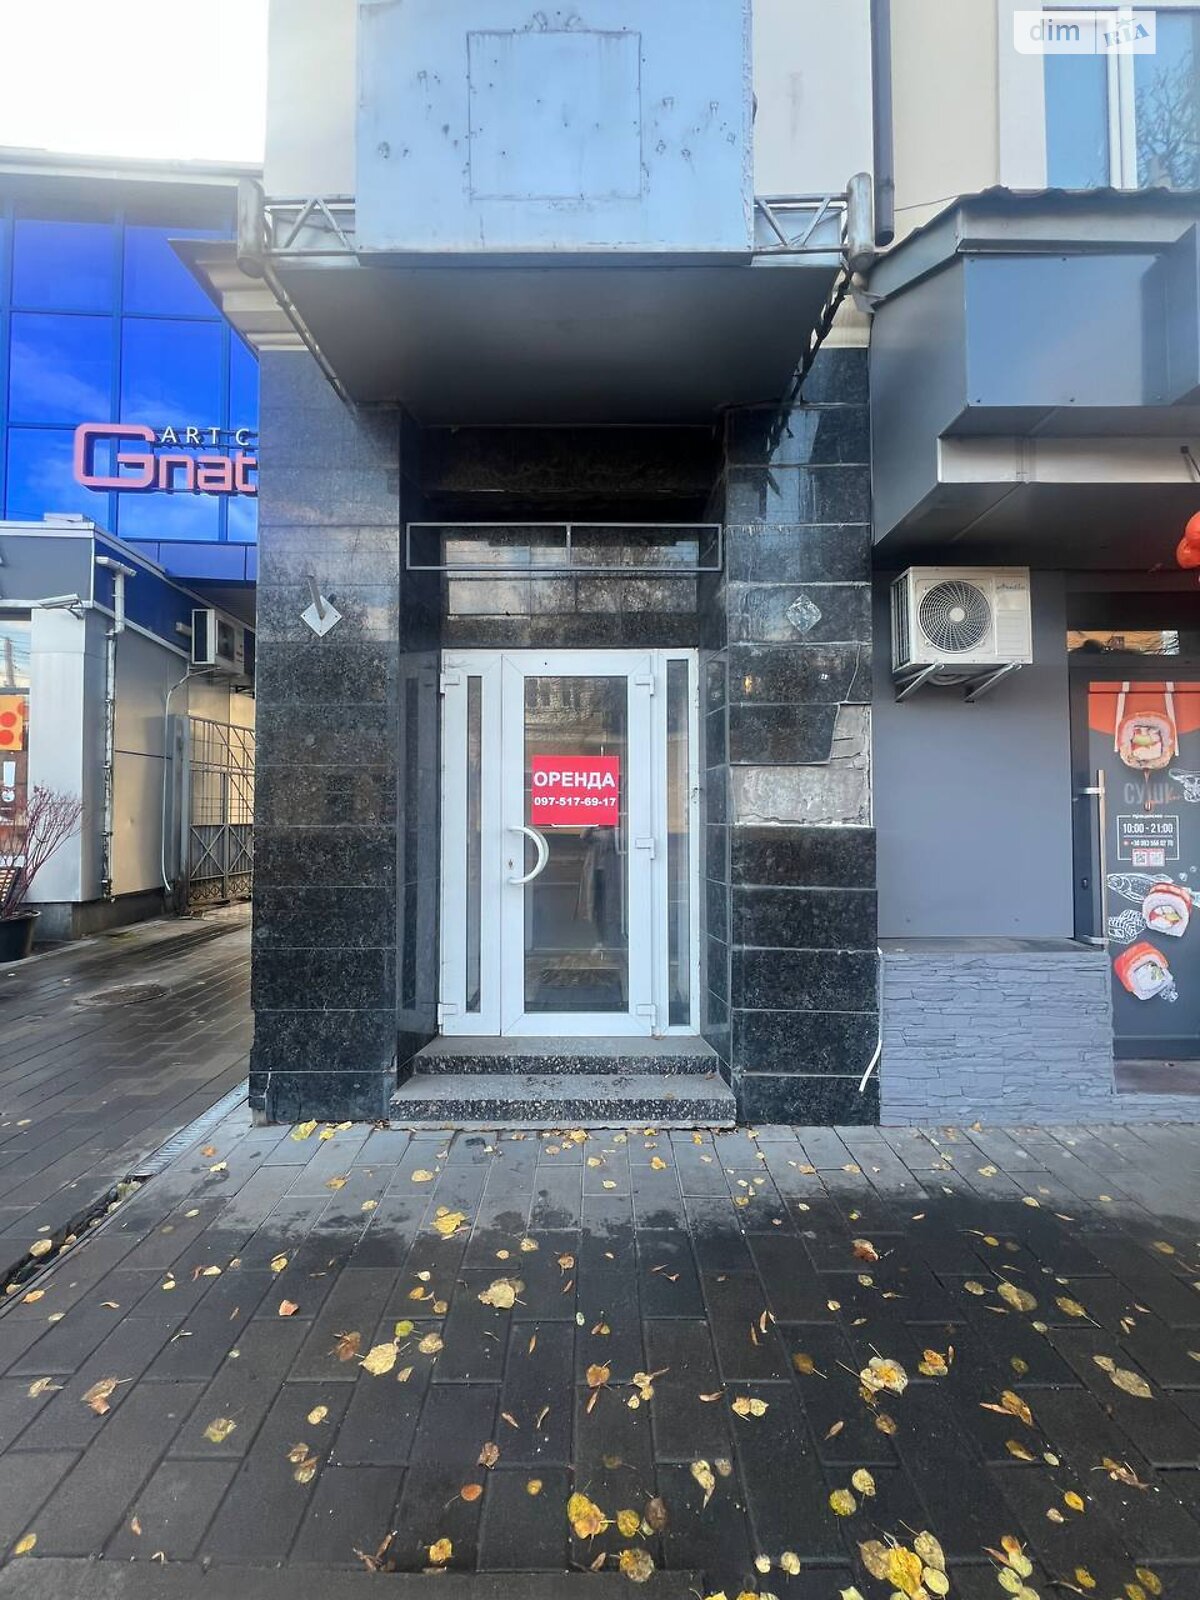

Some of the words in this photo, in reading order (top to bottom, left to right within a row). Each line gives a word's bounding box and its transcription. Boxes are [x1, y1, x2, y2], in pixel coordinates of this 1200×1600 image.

[161, 426, 221, 444] ART
[534, 771, 616, 790] ОРЕНДА
[534, 796, 616, 807] 097-517-69-17
[1123, 823, 1145, 834] 10:00
[1150, 823, 1174, 834] 21:00
